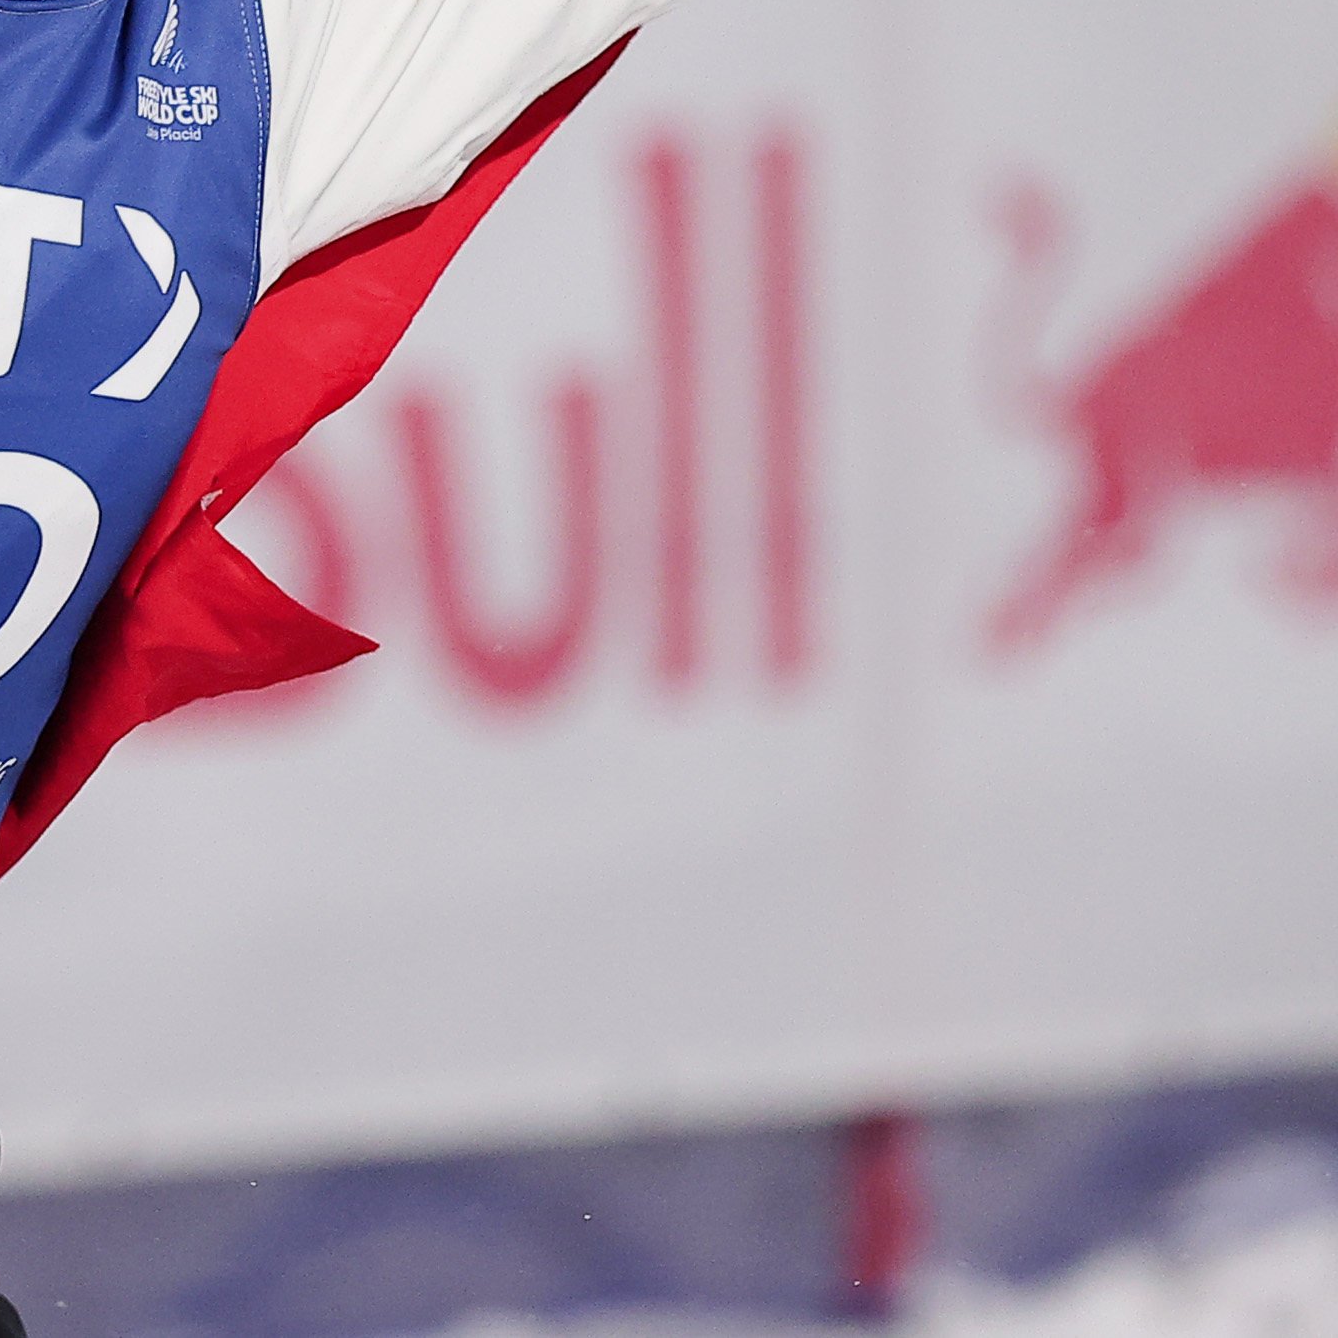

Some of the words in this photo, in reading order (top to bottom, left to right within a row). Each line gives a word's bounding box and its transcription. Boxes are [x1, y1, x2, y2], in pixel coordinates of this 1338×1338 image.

[190, 86, 218, 105] SKI
[137, 95, 175, 126] WOLD
[175, 104, 219, 126] CUP
[160, 127, 202, 141] Placid
